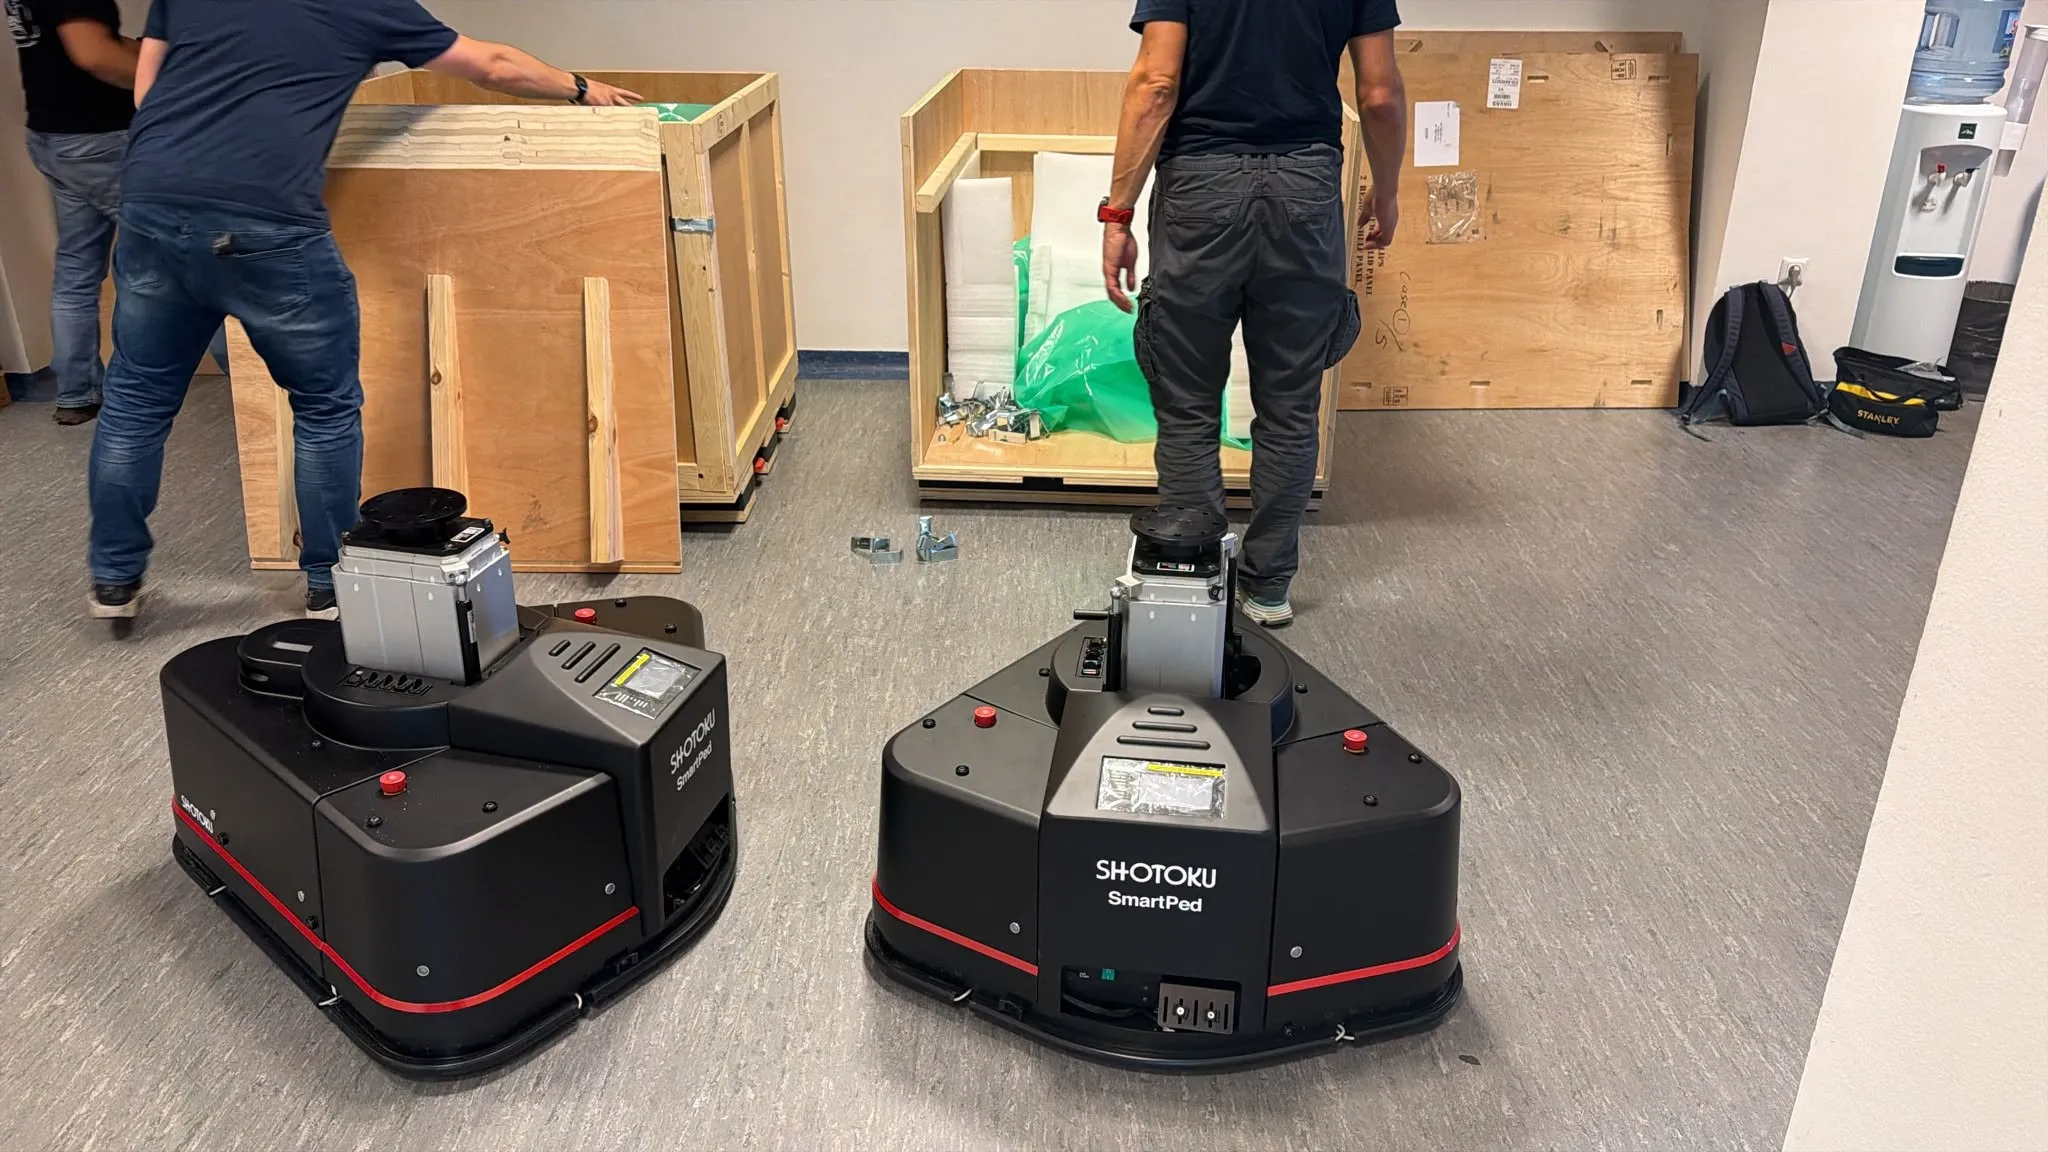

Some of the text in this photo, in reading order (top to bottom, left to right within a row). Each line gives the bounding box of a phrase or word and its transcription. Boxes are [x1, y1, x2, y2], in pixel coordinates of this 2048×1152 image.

[1355, 256, 1363, 283] PANEL
[1366, 251, 1375, 295] LID PANEL
[1857, 409, 1900, 425] STANLEY
[670, 707, 715, 775] SHOTOKU
[677, 740, 712, 791] SmartPed
[1096, 859, 1217, 889] SHOTOKU
[1108, 890, 1203, 912] SmartPed
